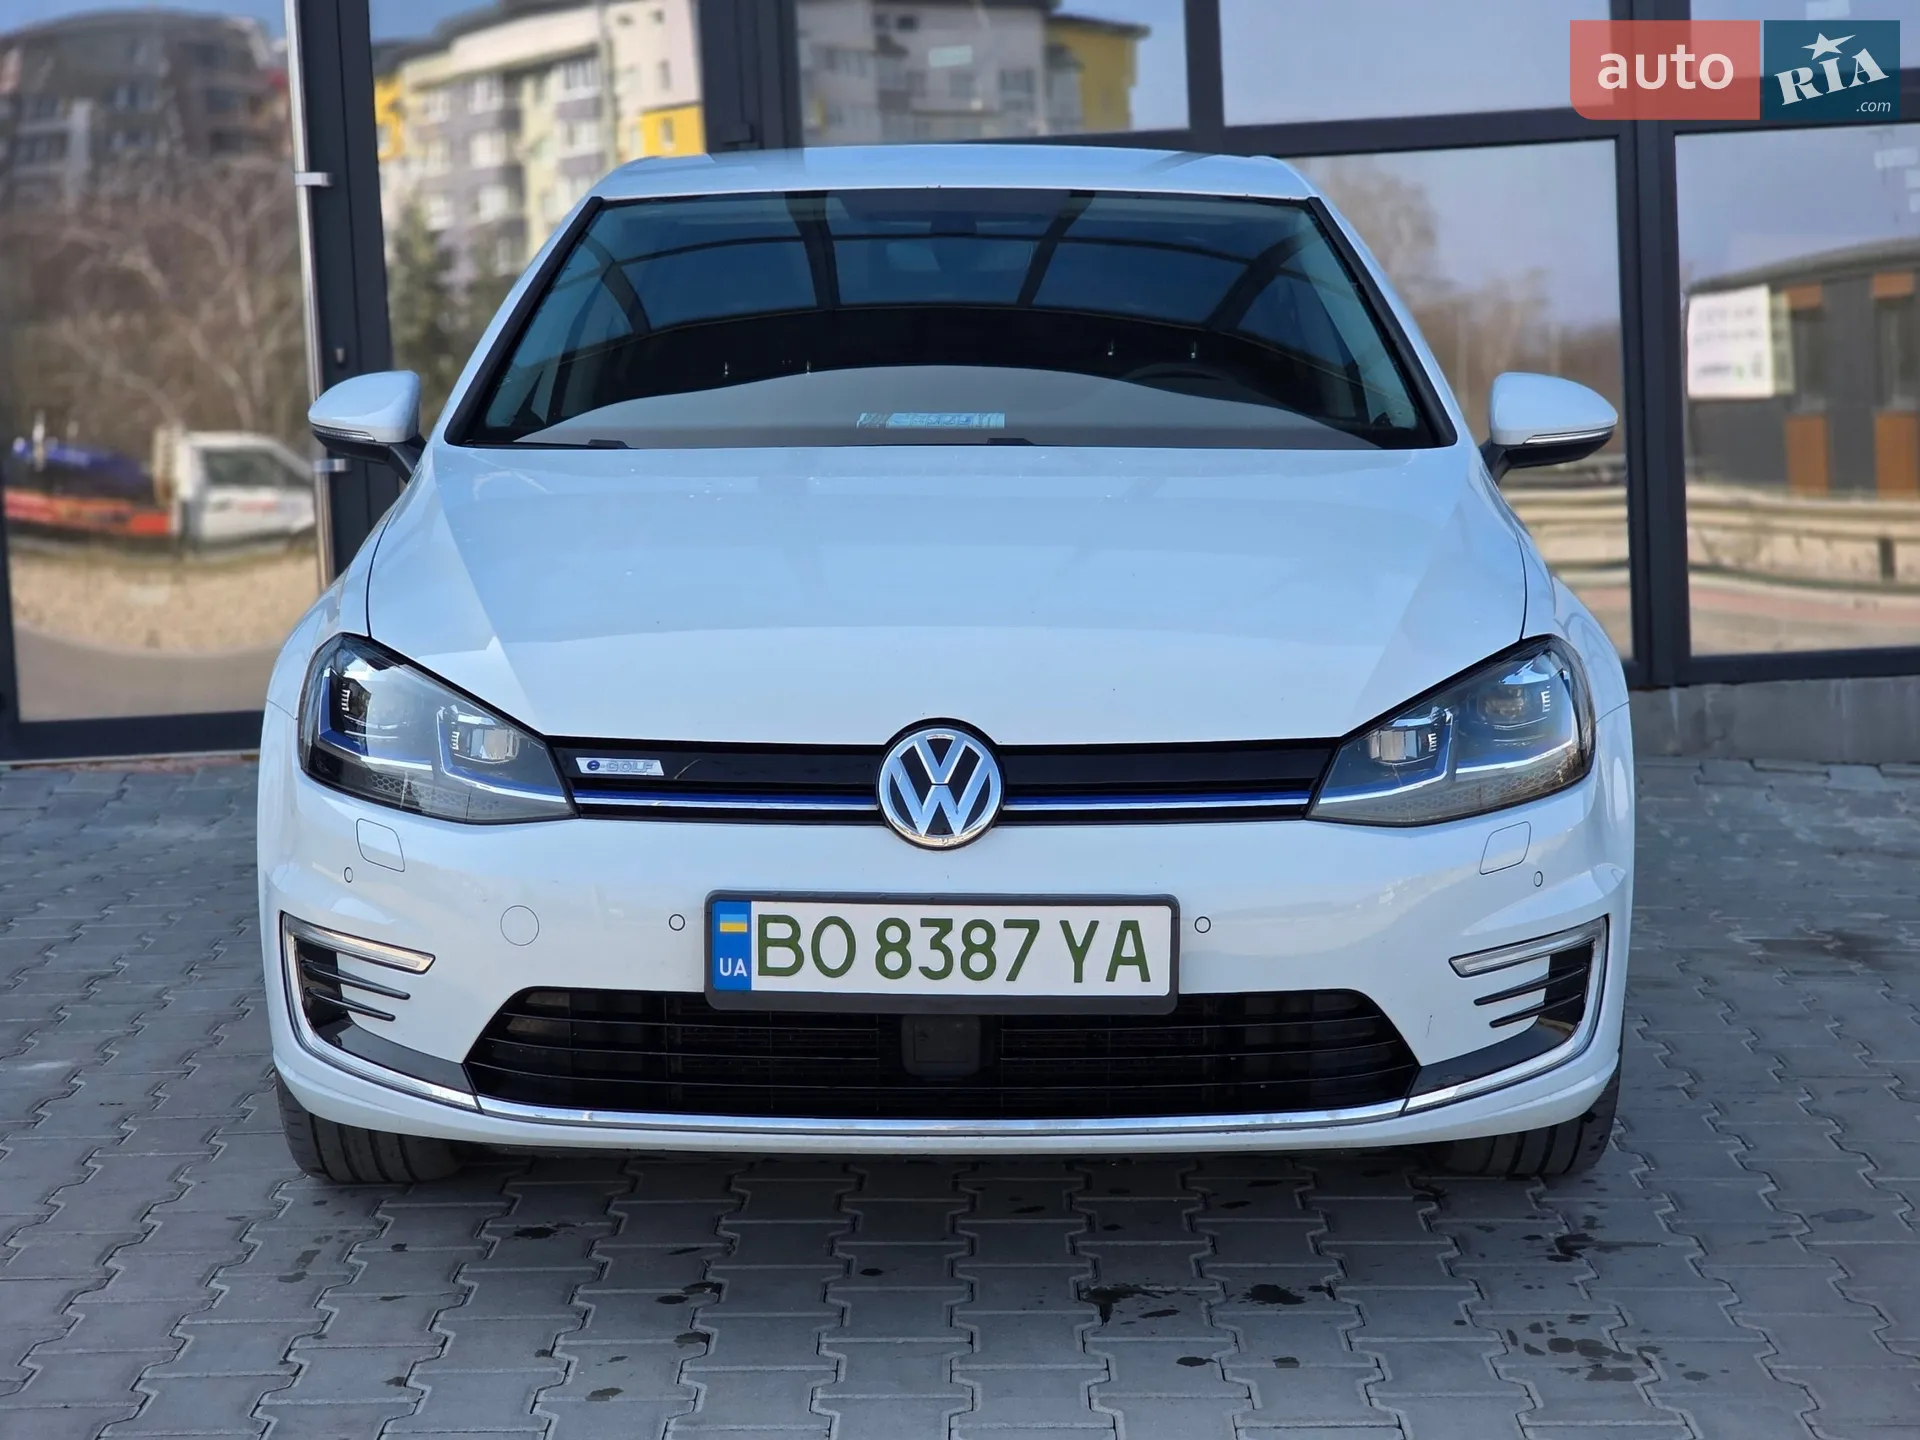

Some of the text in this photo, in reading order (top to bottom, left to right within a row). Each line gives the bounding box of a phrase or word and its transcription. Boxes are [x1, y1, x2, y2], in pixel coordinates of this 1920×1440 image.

[879, 728, 1001, 847] VW
[719, 957, 748, 978] UA
[757, 914, 1152, 983] BO 8387 YA
